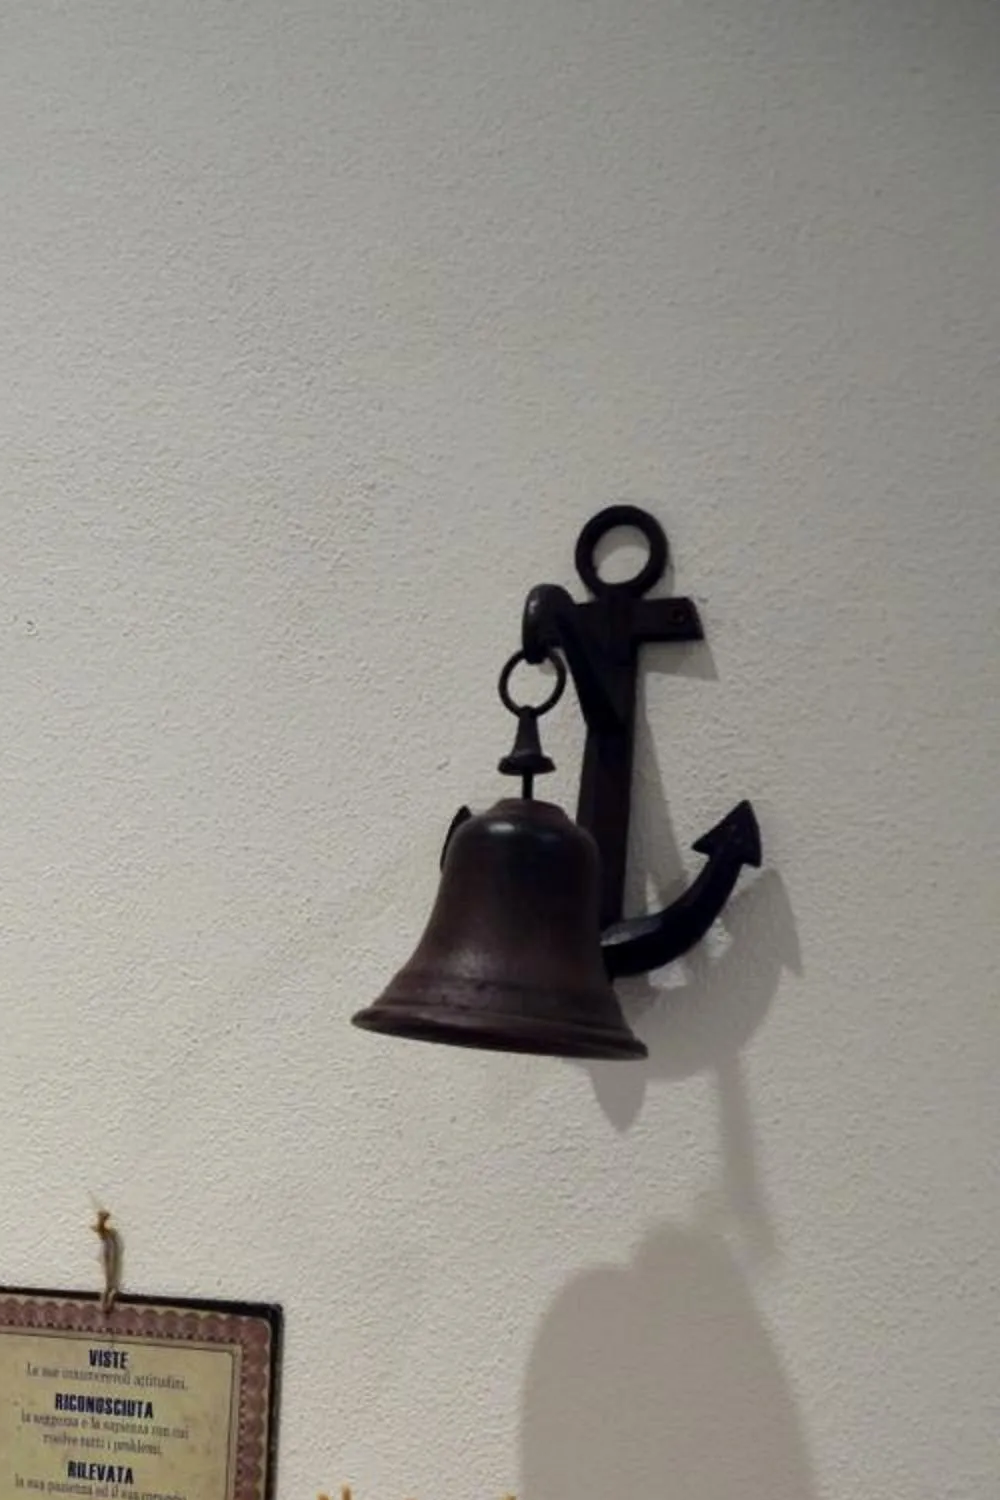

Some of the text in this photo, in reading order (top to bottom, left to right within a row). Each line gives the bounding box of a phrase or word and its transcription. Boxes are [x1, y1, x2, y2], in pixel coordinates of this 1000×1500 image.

[89, 1349, 129, 1370] VISTE
[55, 1393, 153, 1418] RICONOSCIUTA
[67, 1461, 134, 1484] RILEVATA
